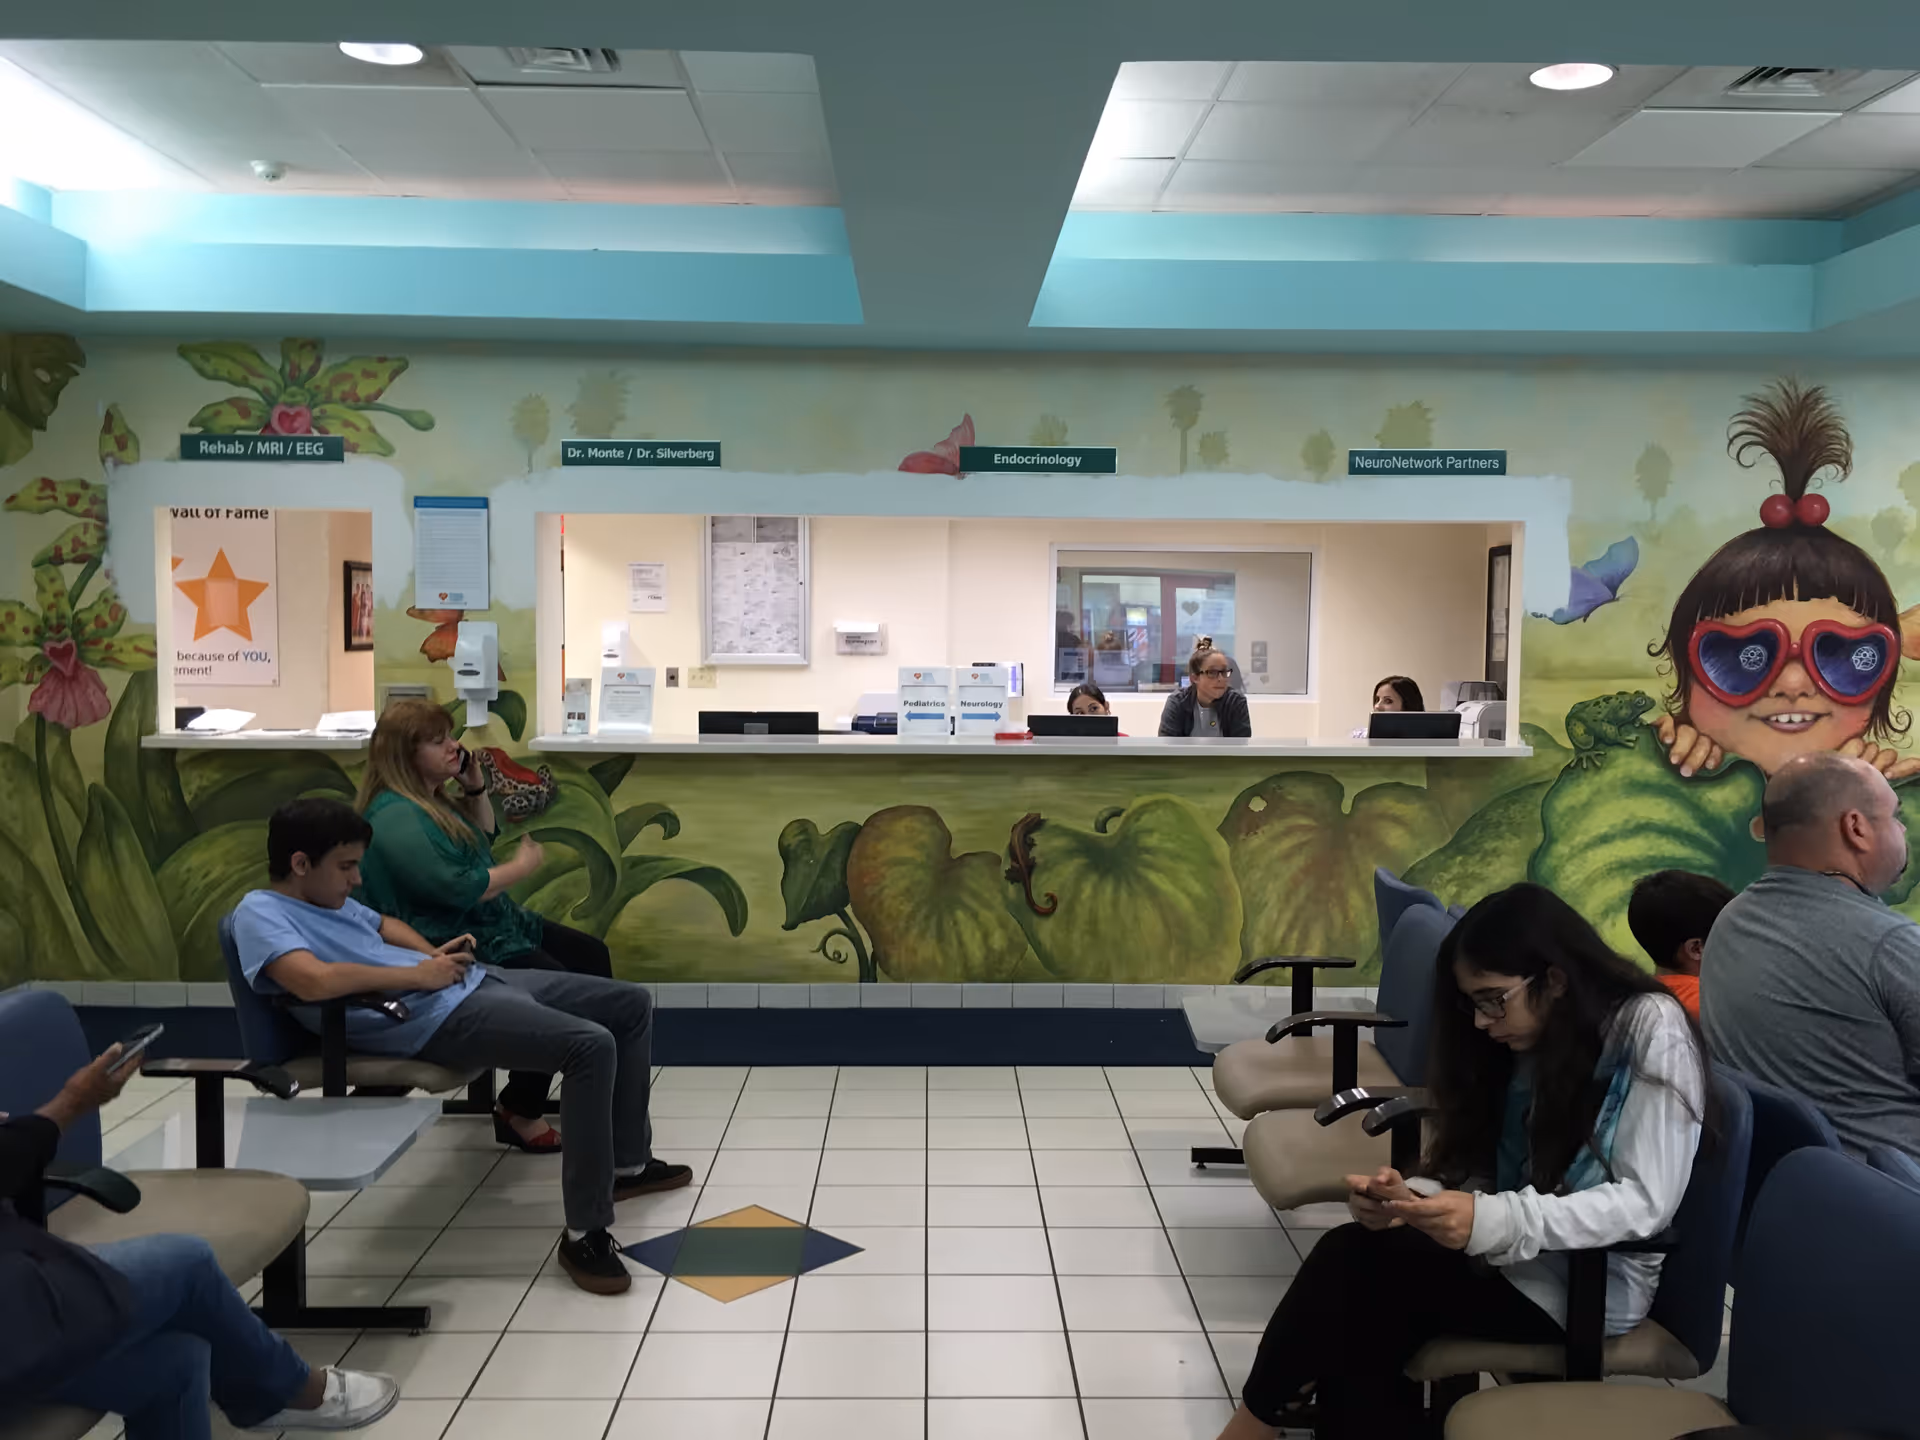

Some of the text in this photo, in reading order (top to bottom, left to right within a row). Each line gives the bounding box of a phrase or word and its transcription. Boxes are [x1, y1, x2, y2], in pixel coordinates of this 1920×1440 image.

[199, 440, 324, 456] Rehab / MRI / EEG
[567, 447, 715, 462] Dr. Monte / Dr. Silverberg
[993, 453, 1082, 468] Endocrinology
[1354, 456, 1500, 469] NeuroNetwork Partners
[225, 508, 269, 520] Fame
[177, 650, 271, 664] because of YOU,
[903, 700, 946, 708] Pediatrics
[960, 700, 1004, 709] Neurology
